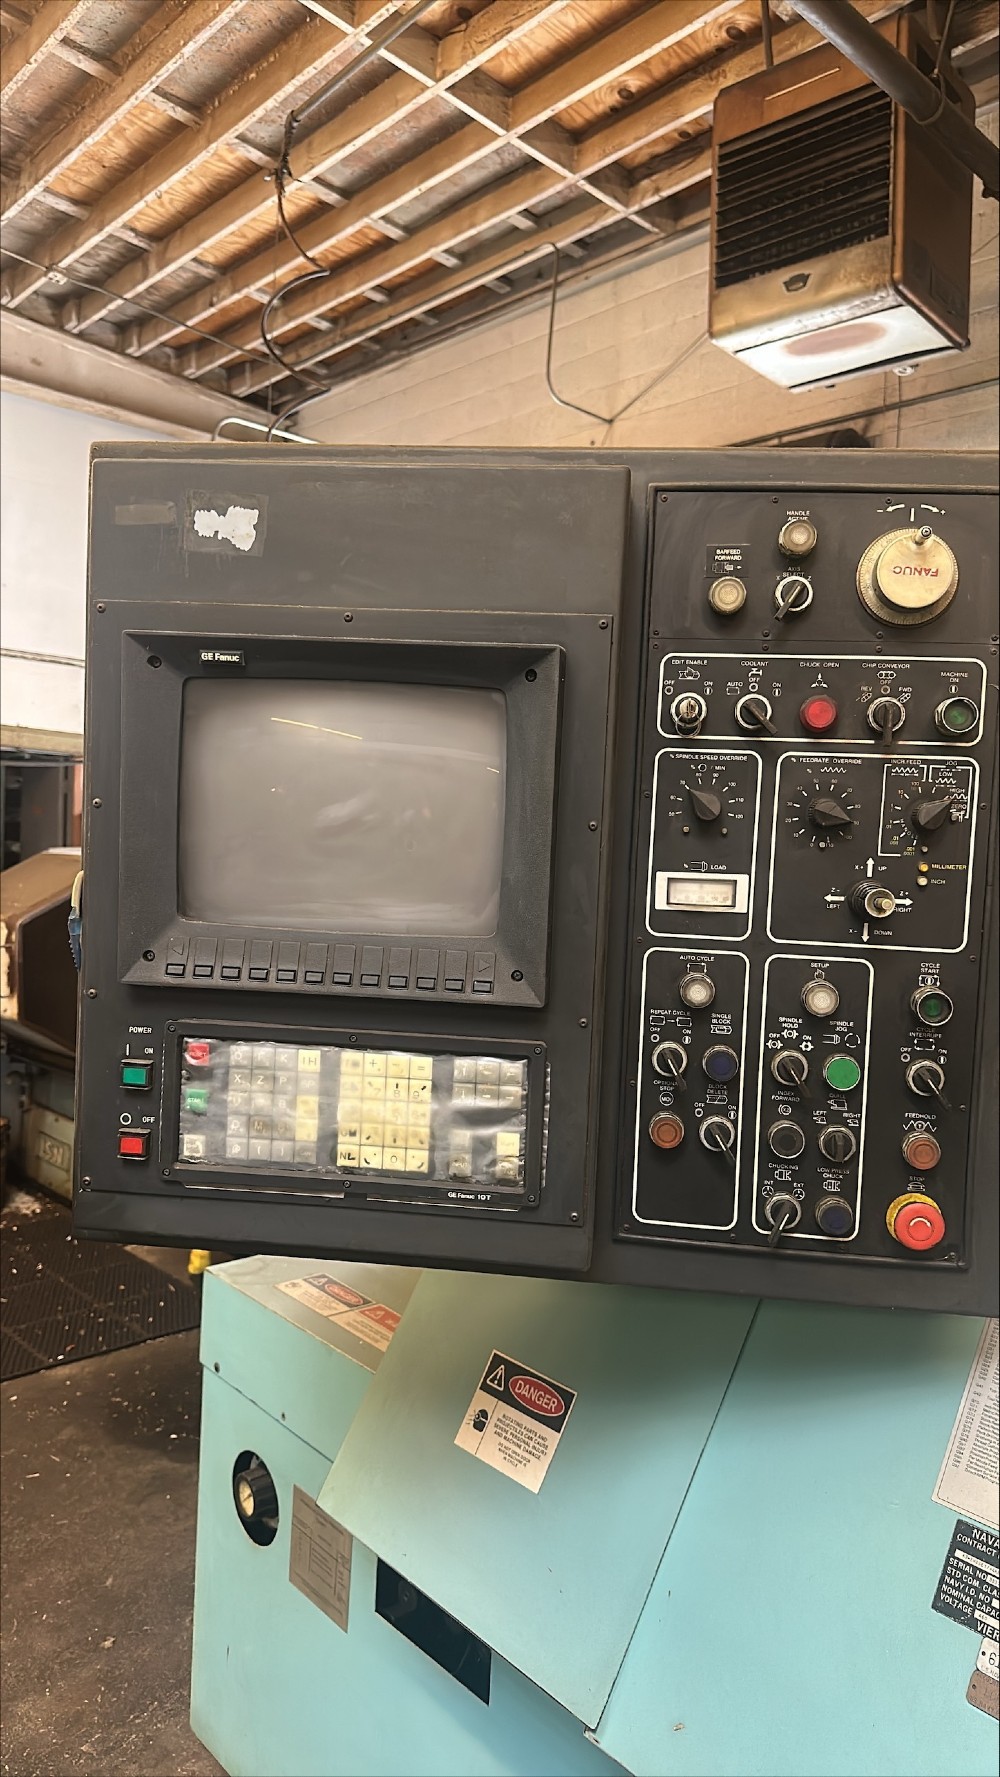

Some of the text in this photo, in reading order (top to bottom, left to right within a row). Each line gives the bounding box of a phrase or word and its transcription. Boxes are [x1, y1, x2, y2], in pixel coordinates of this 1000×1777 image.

[892, 565, 939, 577] FANUC
[214, 653, 240, 662] Fanuc
[129, 1026, 152, 1034] POWER
[905, 1112, 936, 1120] FEEDHOLD
[515, 1380, 557, 1412] DANGER
[494, 1423, 547, 1456] SEVERE PERSONAL INJURY
[494, 1430, 503, 1438] AND
[503, 1434, 521, 1449] MACHINE
[497, 1418, 549, 1450] PROJECTILES CAN CAUSE
[502, 1414, 548, 1442] ROTATING PARTS AND
[956, 1533, 997, 1557] CONTRACT
[946, 1567, 962, 1578] STD
[962, 1575, 981, 1589] COM.
[949, 1557, 974, 1575] SERIAL
[976, 1570, 987, 1581] NO
[942, 1584, 974, 1606] NOMINAL
[944, 1575, 965, 1590] NAVY
[978, 1592, 990, 1603] NO
[940, 1592, 973, 1615] VOLTAGE
